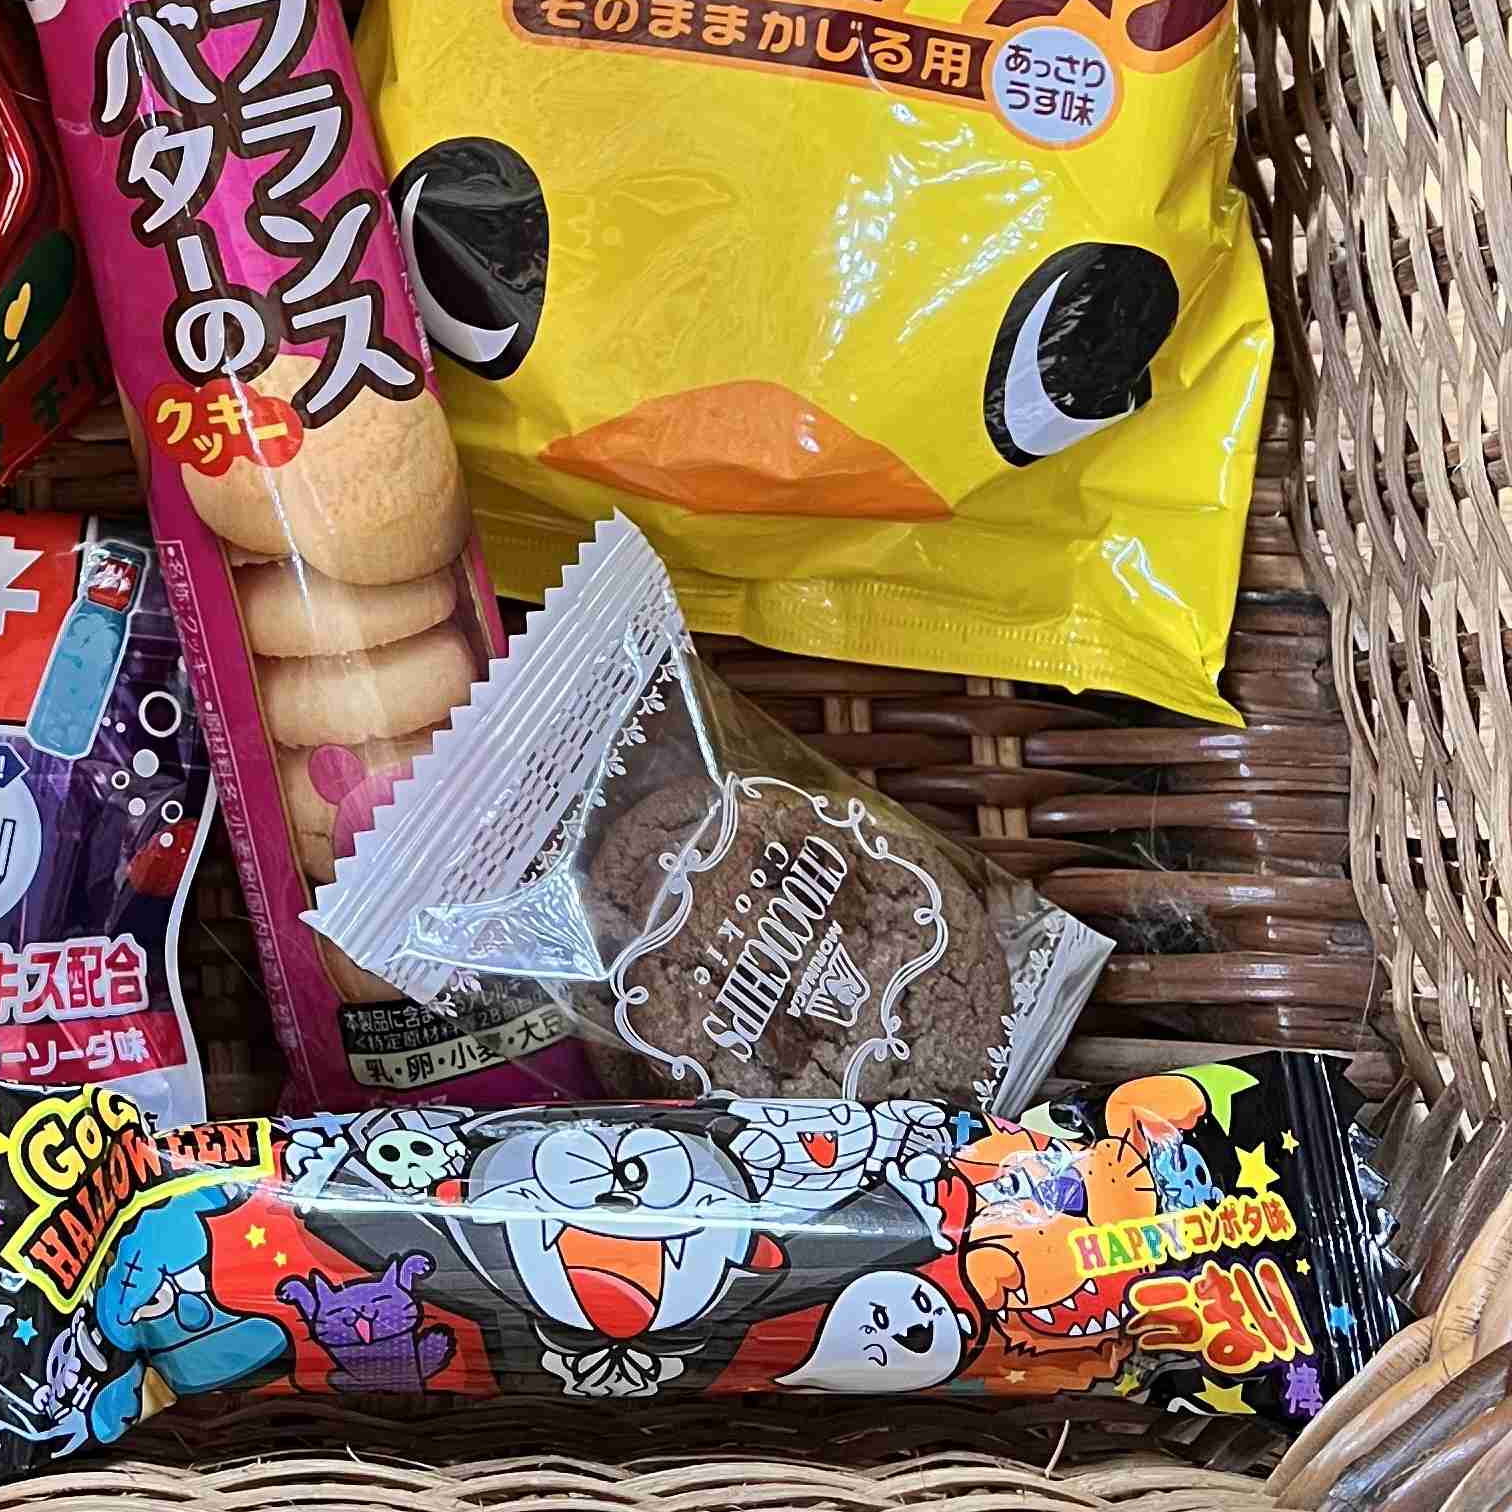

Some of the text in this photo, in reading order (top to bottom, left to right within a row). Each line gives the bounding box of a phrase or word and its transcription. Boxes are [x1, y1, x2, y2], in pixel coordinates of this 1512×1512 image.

[1003, 42, 1108, 90] あっさり
[1005, 85, 1097, 126] うす味
[100, 1, 267, 374] バターの
[155, 397, 288, 464] クッキー
[702, 835, 848, 1064] CHOCOCHIPS
[1126, 1258, 1315, 1374] うまい
